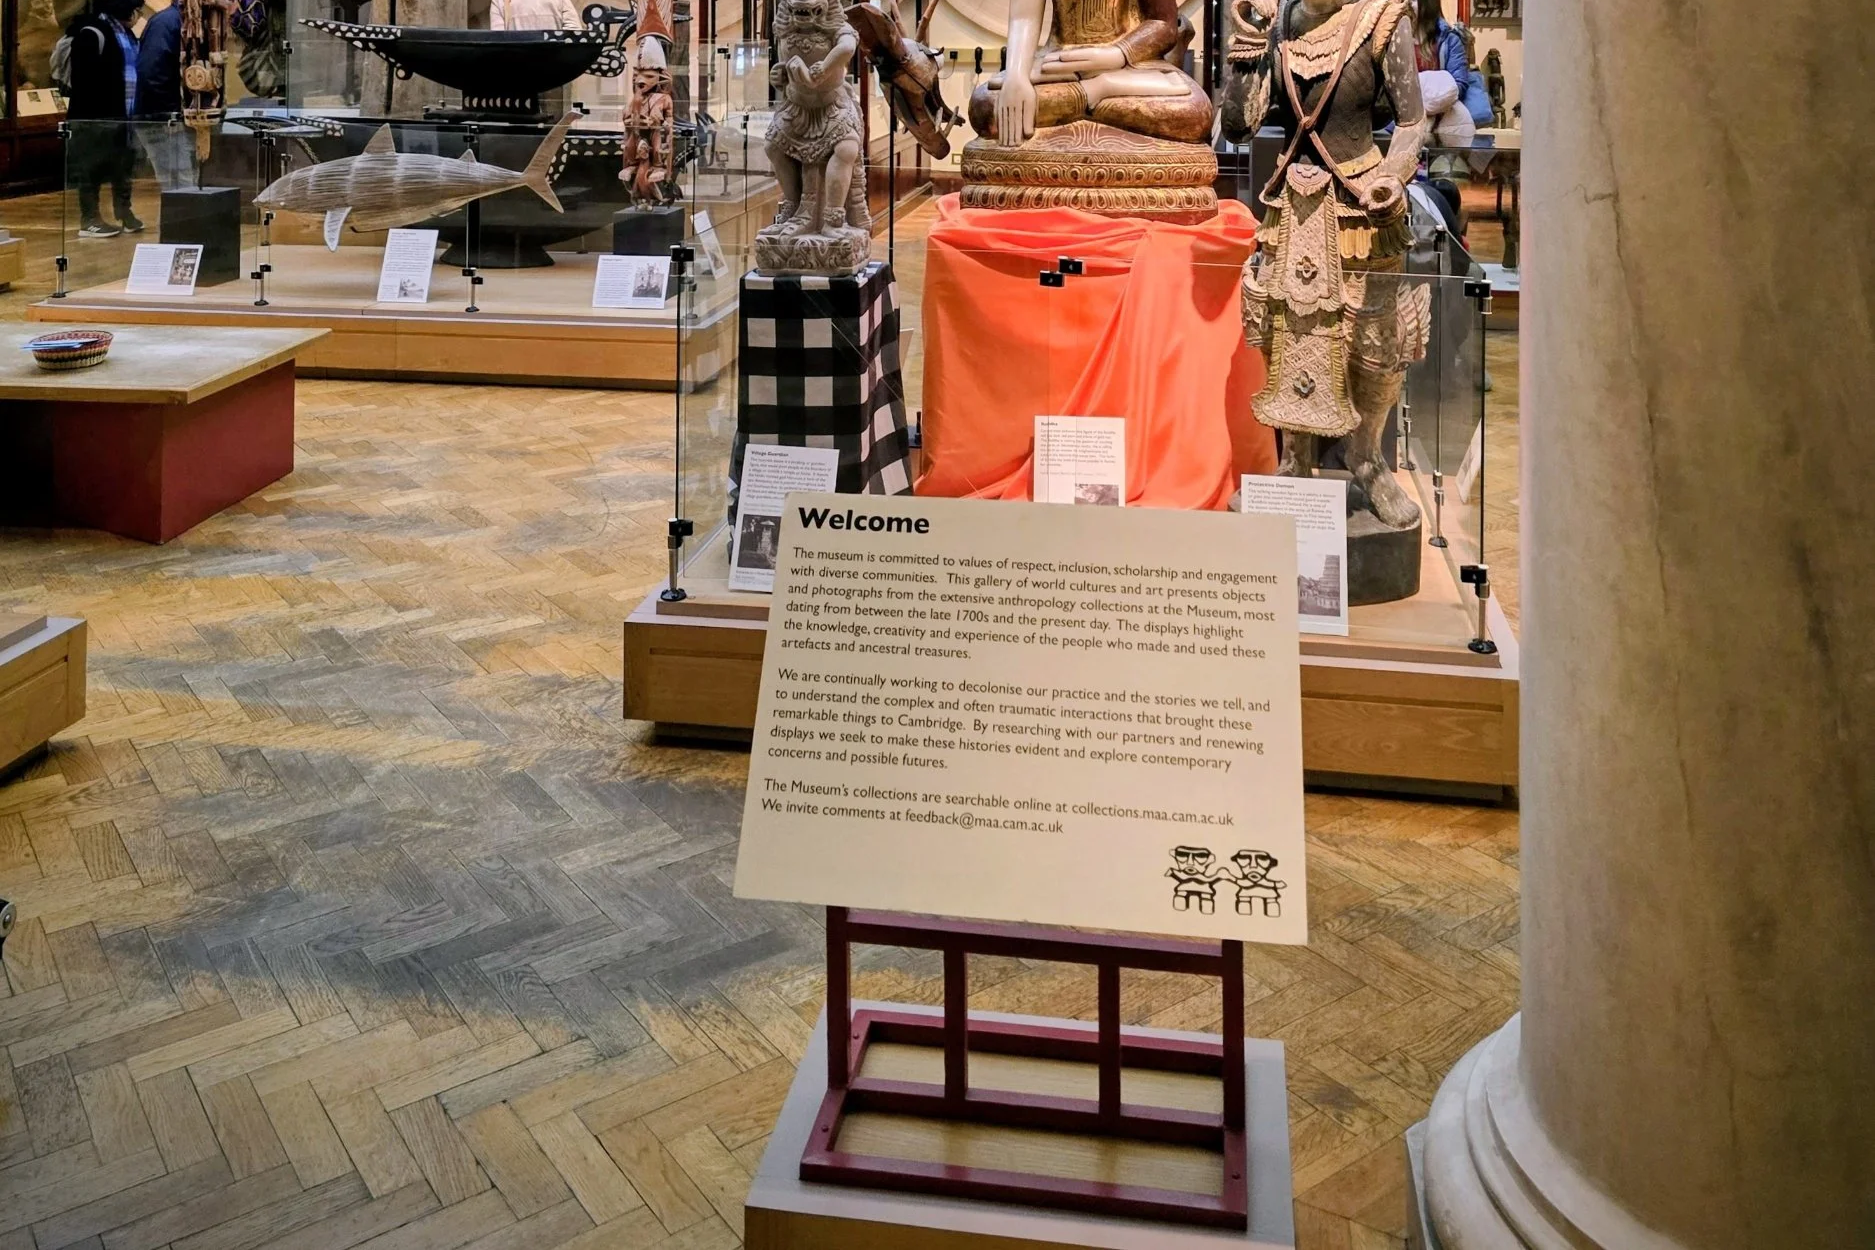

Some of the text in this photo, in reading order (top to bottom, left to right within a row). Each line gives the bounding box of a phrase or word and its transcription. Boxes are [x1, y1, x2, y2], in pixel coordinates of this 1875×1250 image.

[797, 506, 930, 535] Welcome
[790, 565, 1266, 604] with diverse communities. This gallery of world cultures and art presents objects
[792, 546, 1278, 586] The museum is committed to values of respect, inclusion, scholarship and engagement
[785, 599, 1244, 641] dating from between the late 1700s and the present day. The displays highlight
[787, 582, 1276, 622] and photographs from the extensive anthropology collections at the Museum, most
[780, 637, 972, 660] artefacts and ancestral treasures.
[783, 617, 1266, 659] the knowledge, creativity and experience of the people who made and used these
[775, 689, 1253, 731] to understand the complex and often traumatic interactions that brought these
[778, 667, 1271, 712] We are continually working to decolonise our practice and the stories we tell, and
[769, 724, 1232, 773] displays we seek to make these histories evident and explore contemporary
[772, 707, 1265, 756] remarkable things to Cambridge. By researching with our partners and renewing
[767, 747, 948, 769] concerns and possible futures.
[761, 797, 1064, 834] We invite comments at feedback@maa.cam.ac.uk
[763, 777, 788, 792] The
[852, 785, 918, 802] collections
[921, 793, 942, 804] are
[945, 793, 1010, 809] searchable
[1013, 797, 1052, 812] online
[1055, 802, 1068, 814] at
[1071, 801, 1234, 827] collections.maa.cam.ac.uk
